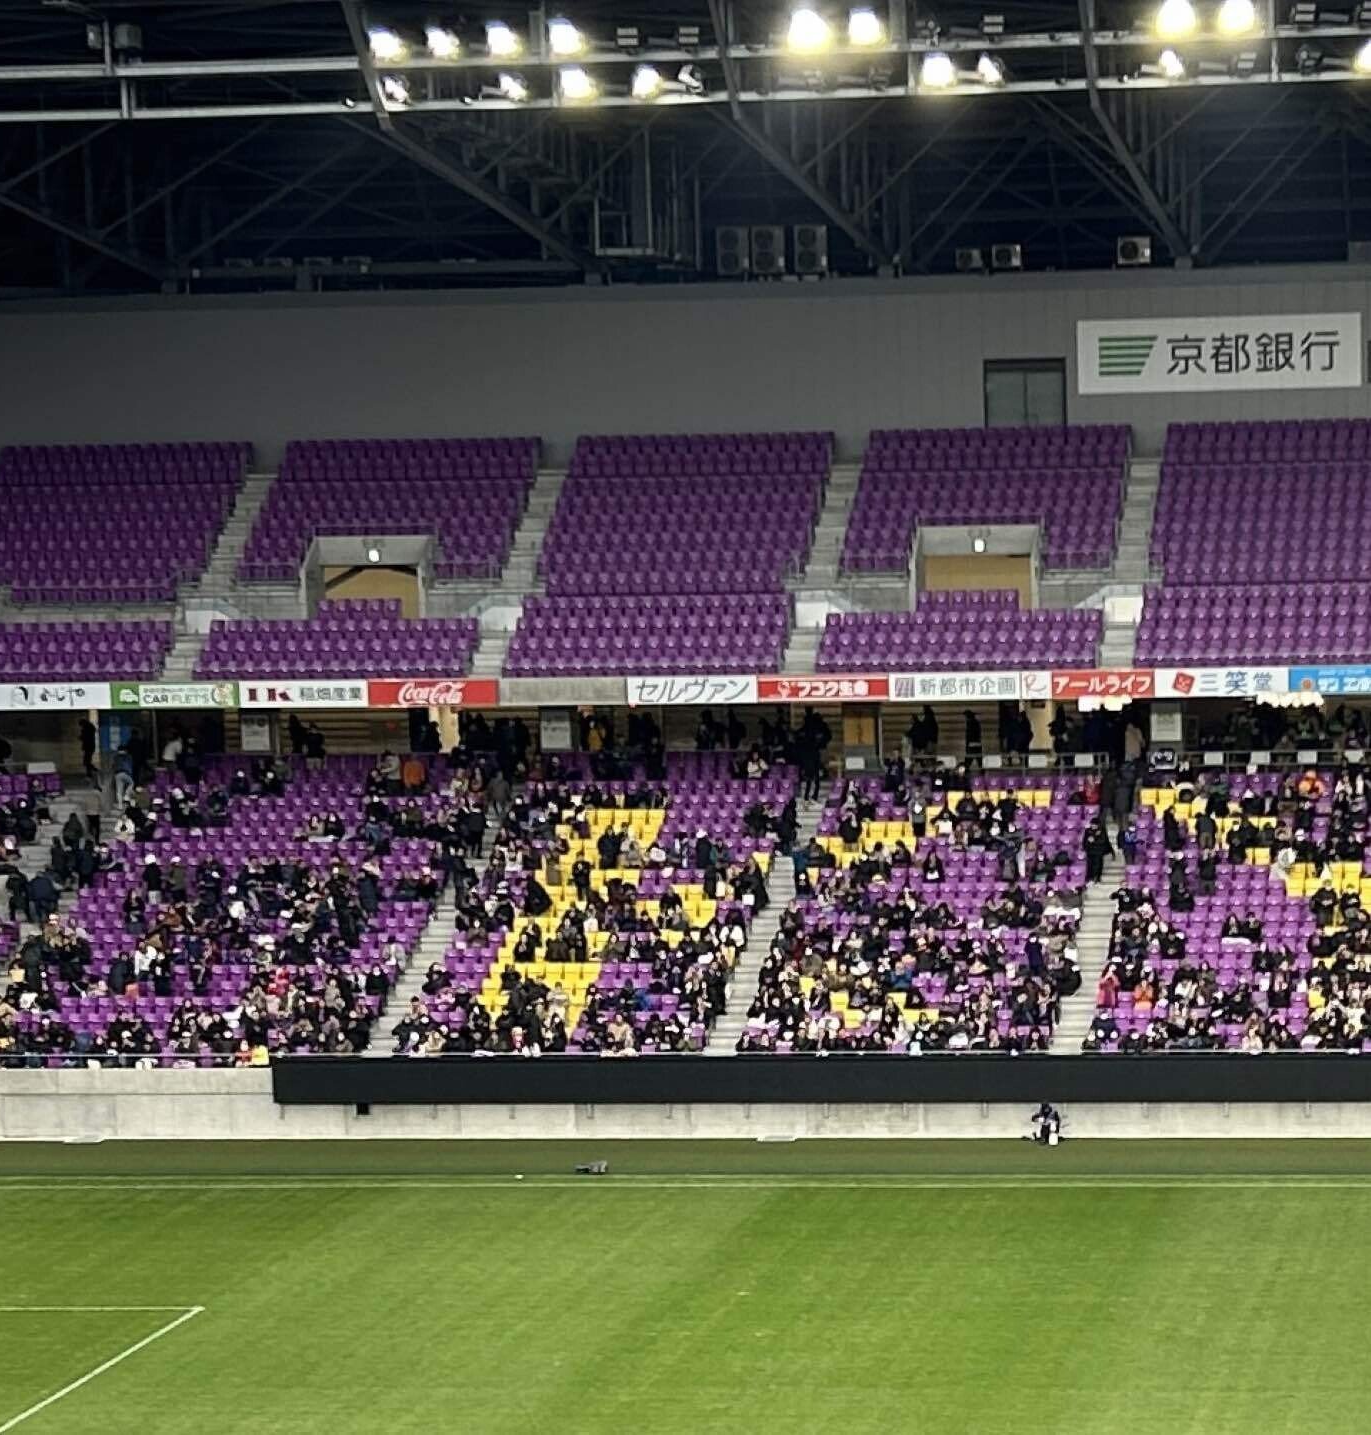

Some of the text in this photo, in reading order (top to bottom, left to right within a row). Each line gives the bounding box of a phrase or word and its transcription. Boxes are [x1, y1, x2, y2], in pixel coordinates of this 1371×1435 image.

[1166, 330, 1341, 376] 京都銀行
[635, 679, 750, 703] セルヴァン
[796, 680, 870, 698] フコク生命
[919, 676, 1016, 696] 新都市企画
[1052, 673, 1152, 695] アールライフ
[1198, 670, 1273, 694] 三笑堂
